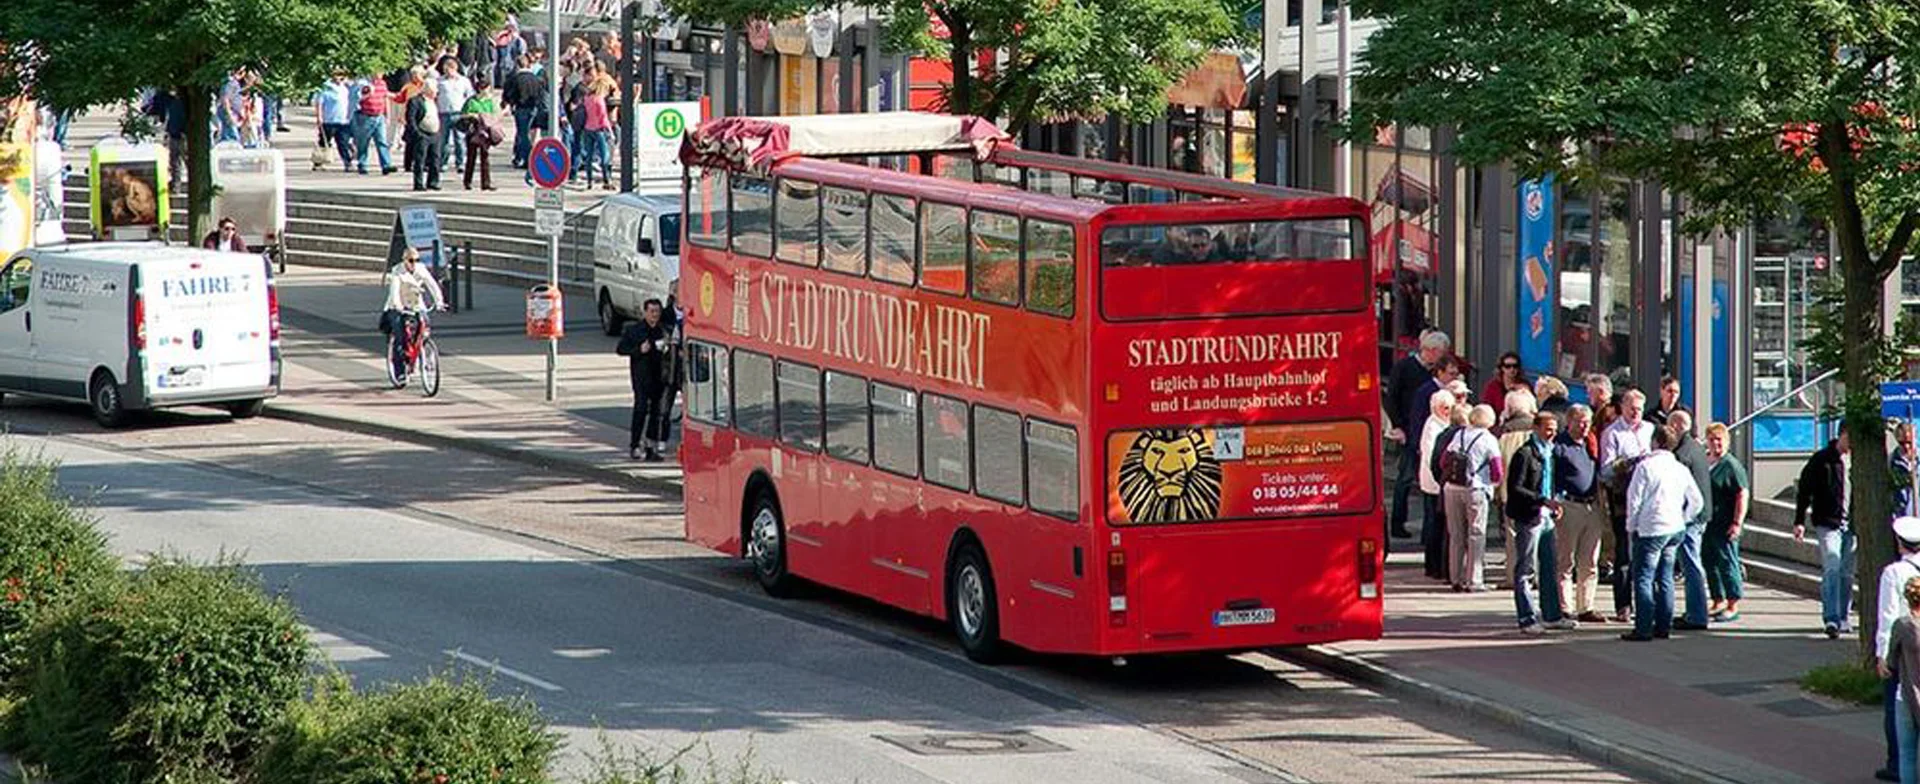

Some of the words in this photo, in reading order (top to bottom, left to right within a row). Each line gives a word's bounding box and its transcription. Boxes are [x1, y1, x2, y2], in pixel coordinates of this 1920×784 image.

[663, 115, 677, 132] H
[760, 271, 991, 389] STADTRUNDFAHRT
[1128, 332, 1342, 367] STADTRUNDFAHRT
[1150, 375, 1198, 395] täglich
[1202, 373, 1219, 389] ab
[1224, 369, 1328, 391] Hauptbahnhof
[1151, 396, 1179, 412] und
[1183, 389, 1301, 412] Landungsbrücke
[1306, 391, 1328, 405] 1-2
[1219, 441, 1232, 454] A
[1261, 472, 1296, 485] Tickets
[1252, 487, 1262, 500] 0
